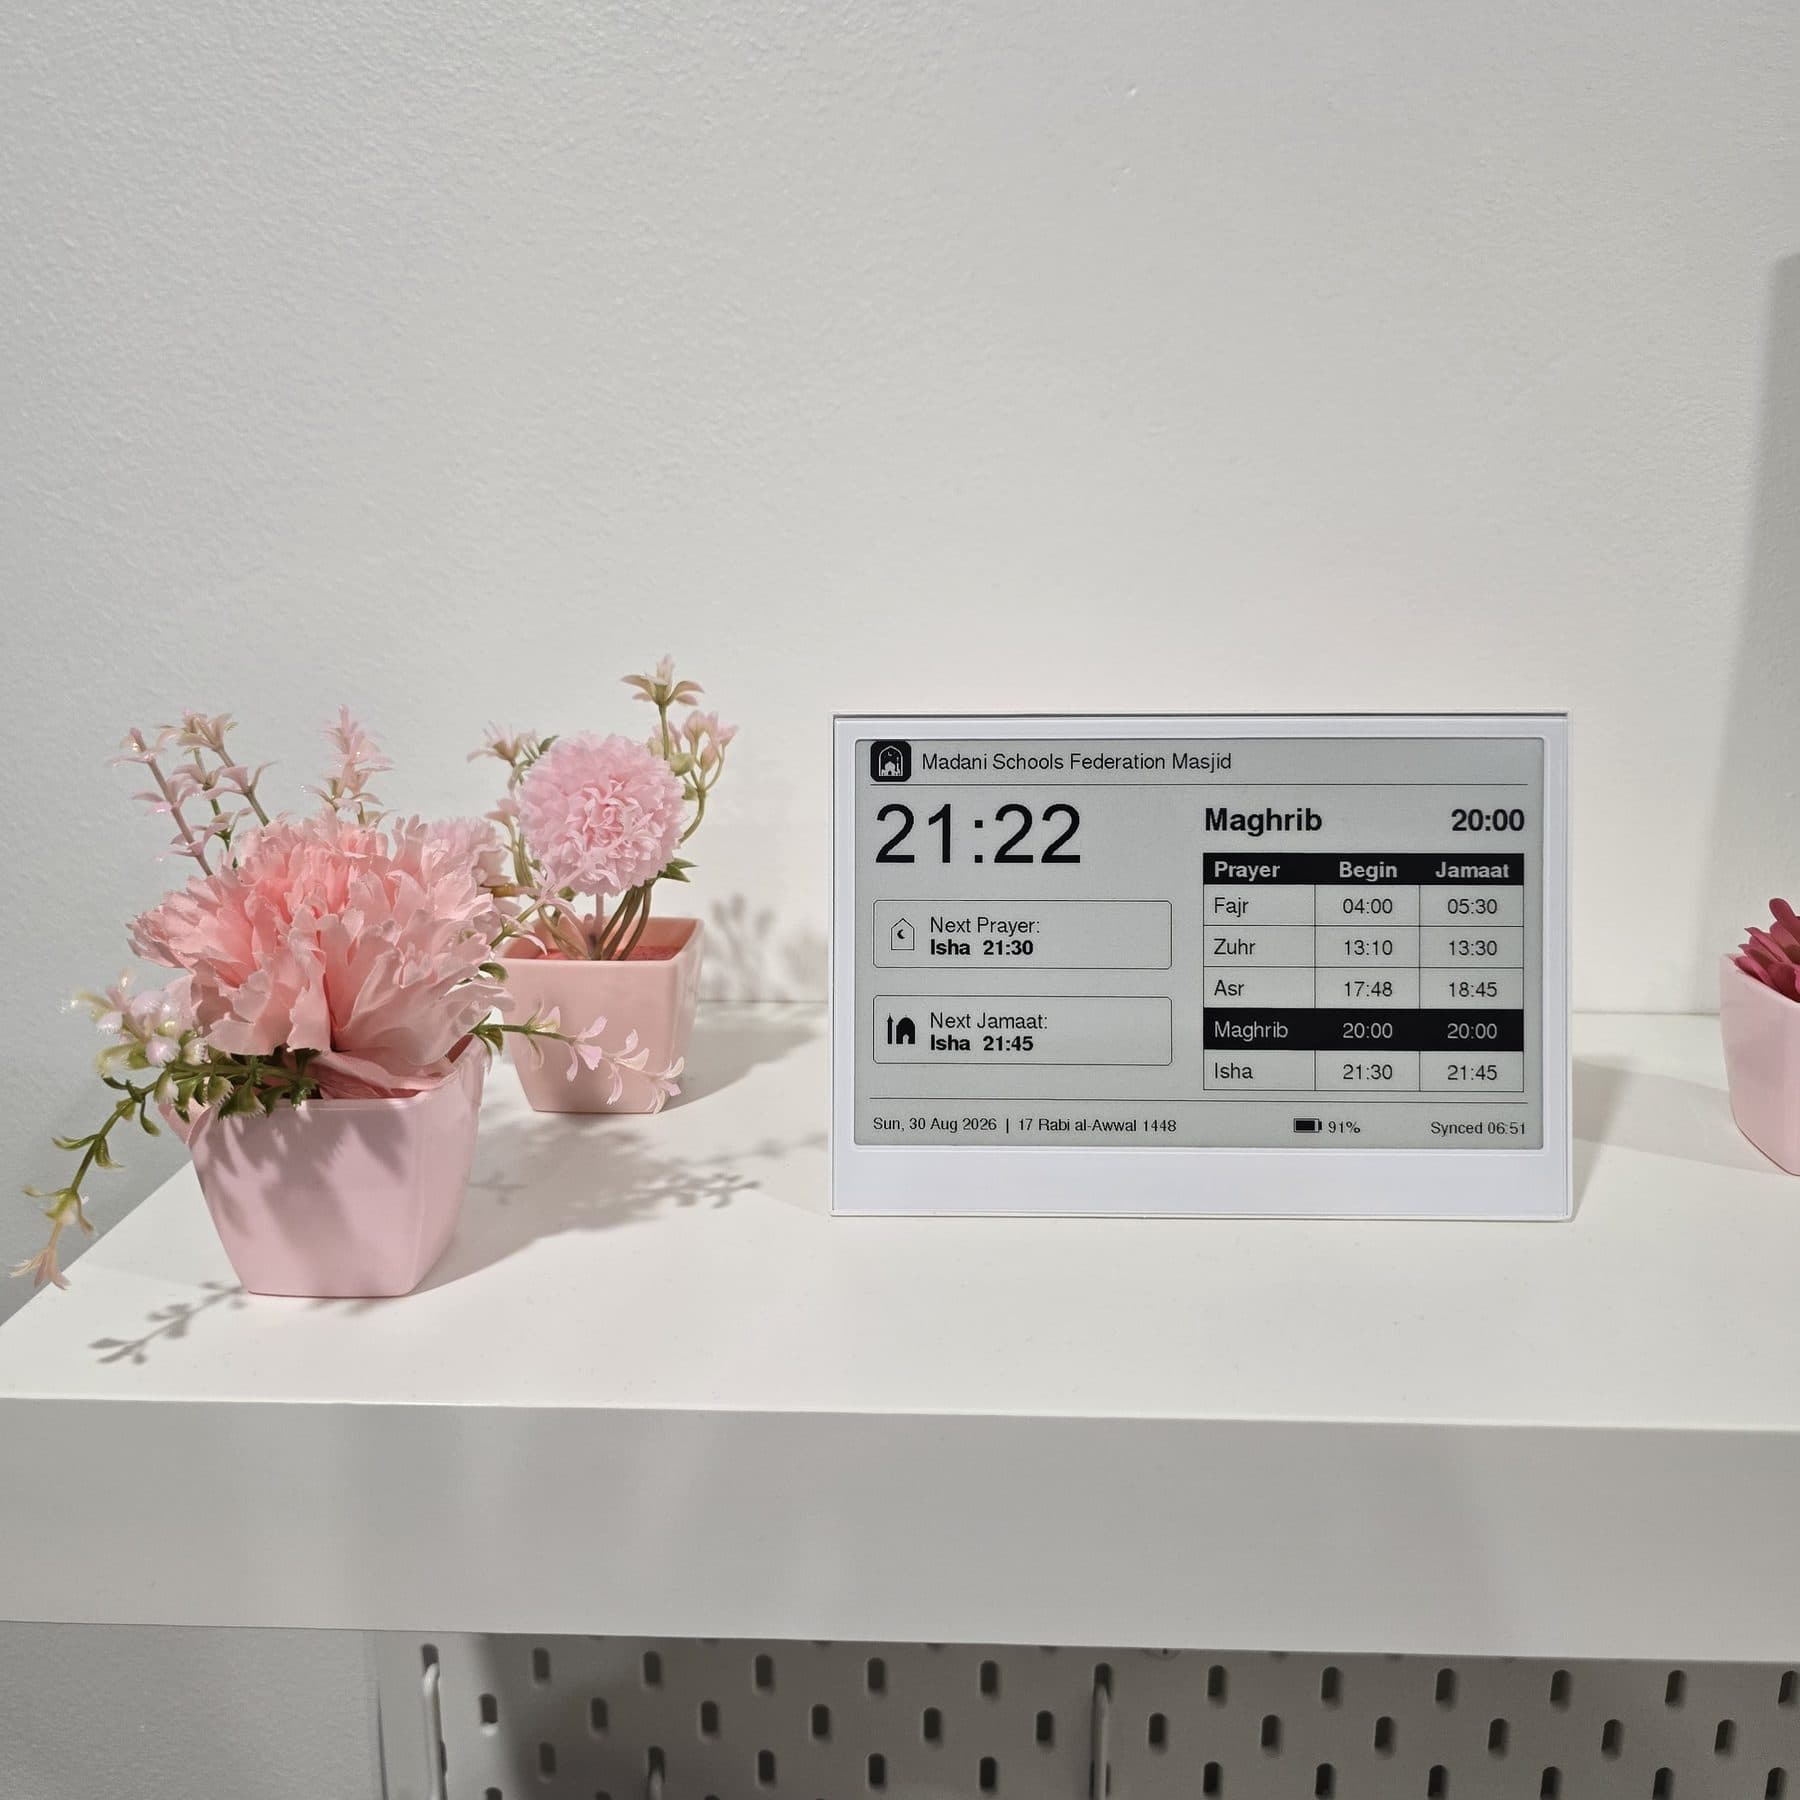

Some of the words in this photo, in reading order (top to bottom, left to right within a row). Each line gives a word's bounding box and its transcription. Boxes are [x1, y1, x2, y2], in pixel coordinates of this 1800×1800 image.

[922, 752, 988, 770] Madani
[992, 752, 1064, 770] Schools
[1070, 752, 1166, 770] Federation
[1172, 752, 1232, 774] Masjid
[1205, 807, 1323, 838] Maghrib
[1451, 808, 1525, 832] 20:00
[875, 803, 1081, 864] 21:22
[1214, 860, 1281, 882] Prayer
[1339, 860, 1398, 882] Begin
[1435, 861, 1510, 879] Jamaat
[1214, 896, 1250, 918] Fajr
[1342, 898, 1393, 915] 04:00
[1447, 898, 1498, 915] 05:30
[930, 916, 972, 934] Next
[977, 916, 1040, 938] Prayer:
[930, 938, 971, 956] Isha
[982, 939, 1034, 956] 21:30
[1213, 937, 1256, 955] Zuhr
[1344, 939, 1393, 956] 13:10
[1448, 939, 1498, 956] 13:30
[1213, 979, 1245, 997] Asr
[1344, 980, 1393, 998] 17:48
[1448, 981, 1498, 998] 18:45
[930, 1011, 972, 1029] Next
[976, 1011, 1048, 1030] Jamaat:
[1214, 1020, 1289, 1042] Maghrib
[1342, 1022, 1393, 1039] 20:00
[1447, 1022, 1498, 1040] 20:00
[930, 1033, 971, 1052] Isha
[982, 1035, 1034, 1052] 21:45
[1214, 1062, 1254, 1080] Isha
[1342, 1063, 1393, 1081] 21:30
[1447, 1064, 1498, 1081] 21:45
[873, 1116, 905, 1132] Sun,
[909, 1117, 926, 1130] 30
[929, 1117, 958, 1134] Aug
[962, 1117, 997, 1131] 2026
[1018, 1118, 1033, 1131] 17
[1038, 1118, 1070, 1132] Rabi
[1074, 1118, 1137, 1132] al-Awwal
[1143, 1119, 1177, 1132] 1448
[1328, 1120, 1361, 1134] 91%
[1430, 1121, 1483, 1138] Synced
[1487, 1121, 1525, 1135] 06:51
